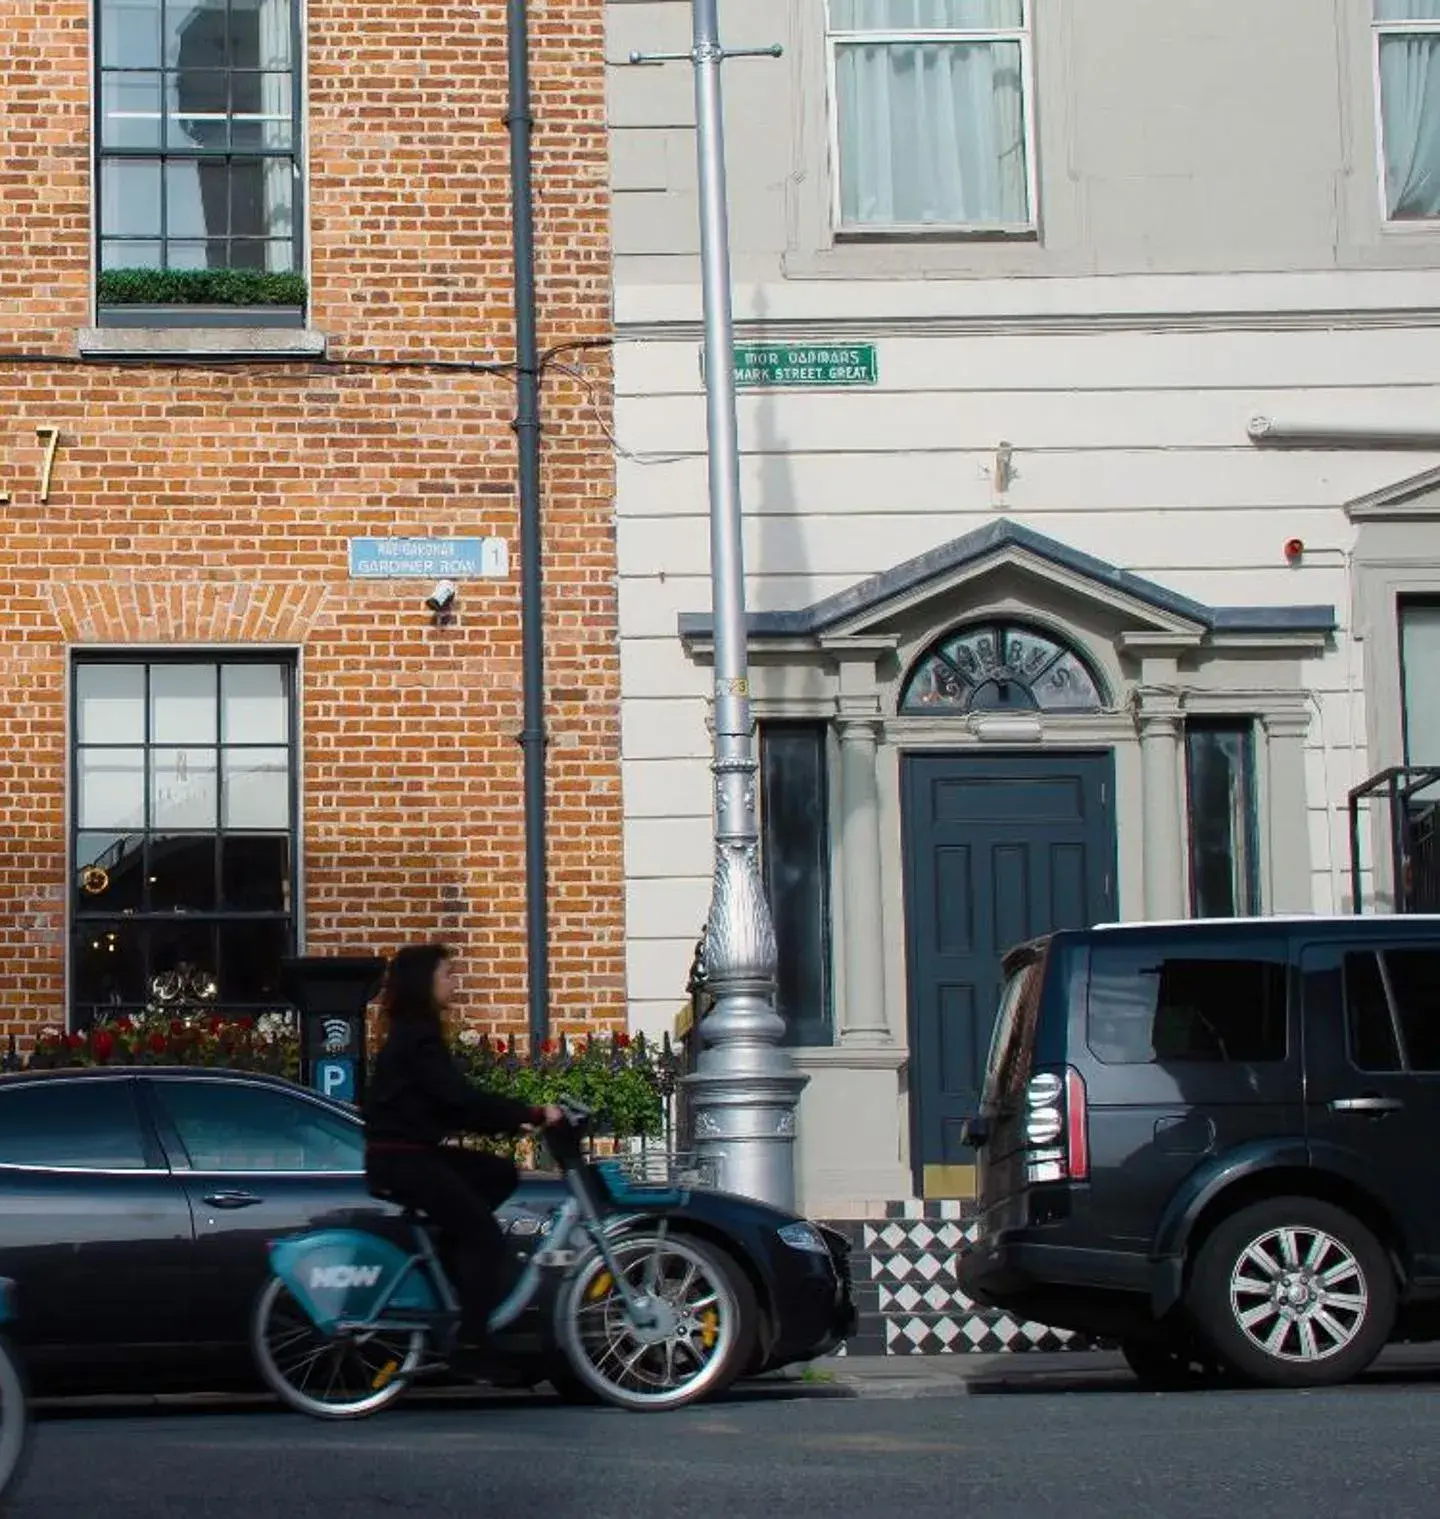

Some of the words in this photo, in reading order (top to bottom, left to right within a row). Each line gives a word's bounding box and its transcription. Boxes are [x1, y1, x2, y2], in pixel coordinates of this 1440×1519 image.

[733, 367, 770, 381] MARK
[775, 367, 823, 380] STREET
[828, 366, 869, 379] GREAT
[439, 558, 476, 573] ROW
[323, 1064, 347, 1096] P
[310, 1264, 383, 1289] NOW
